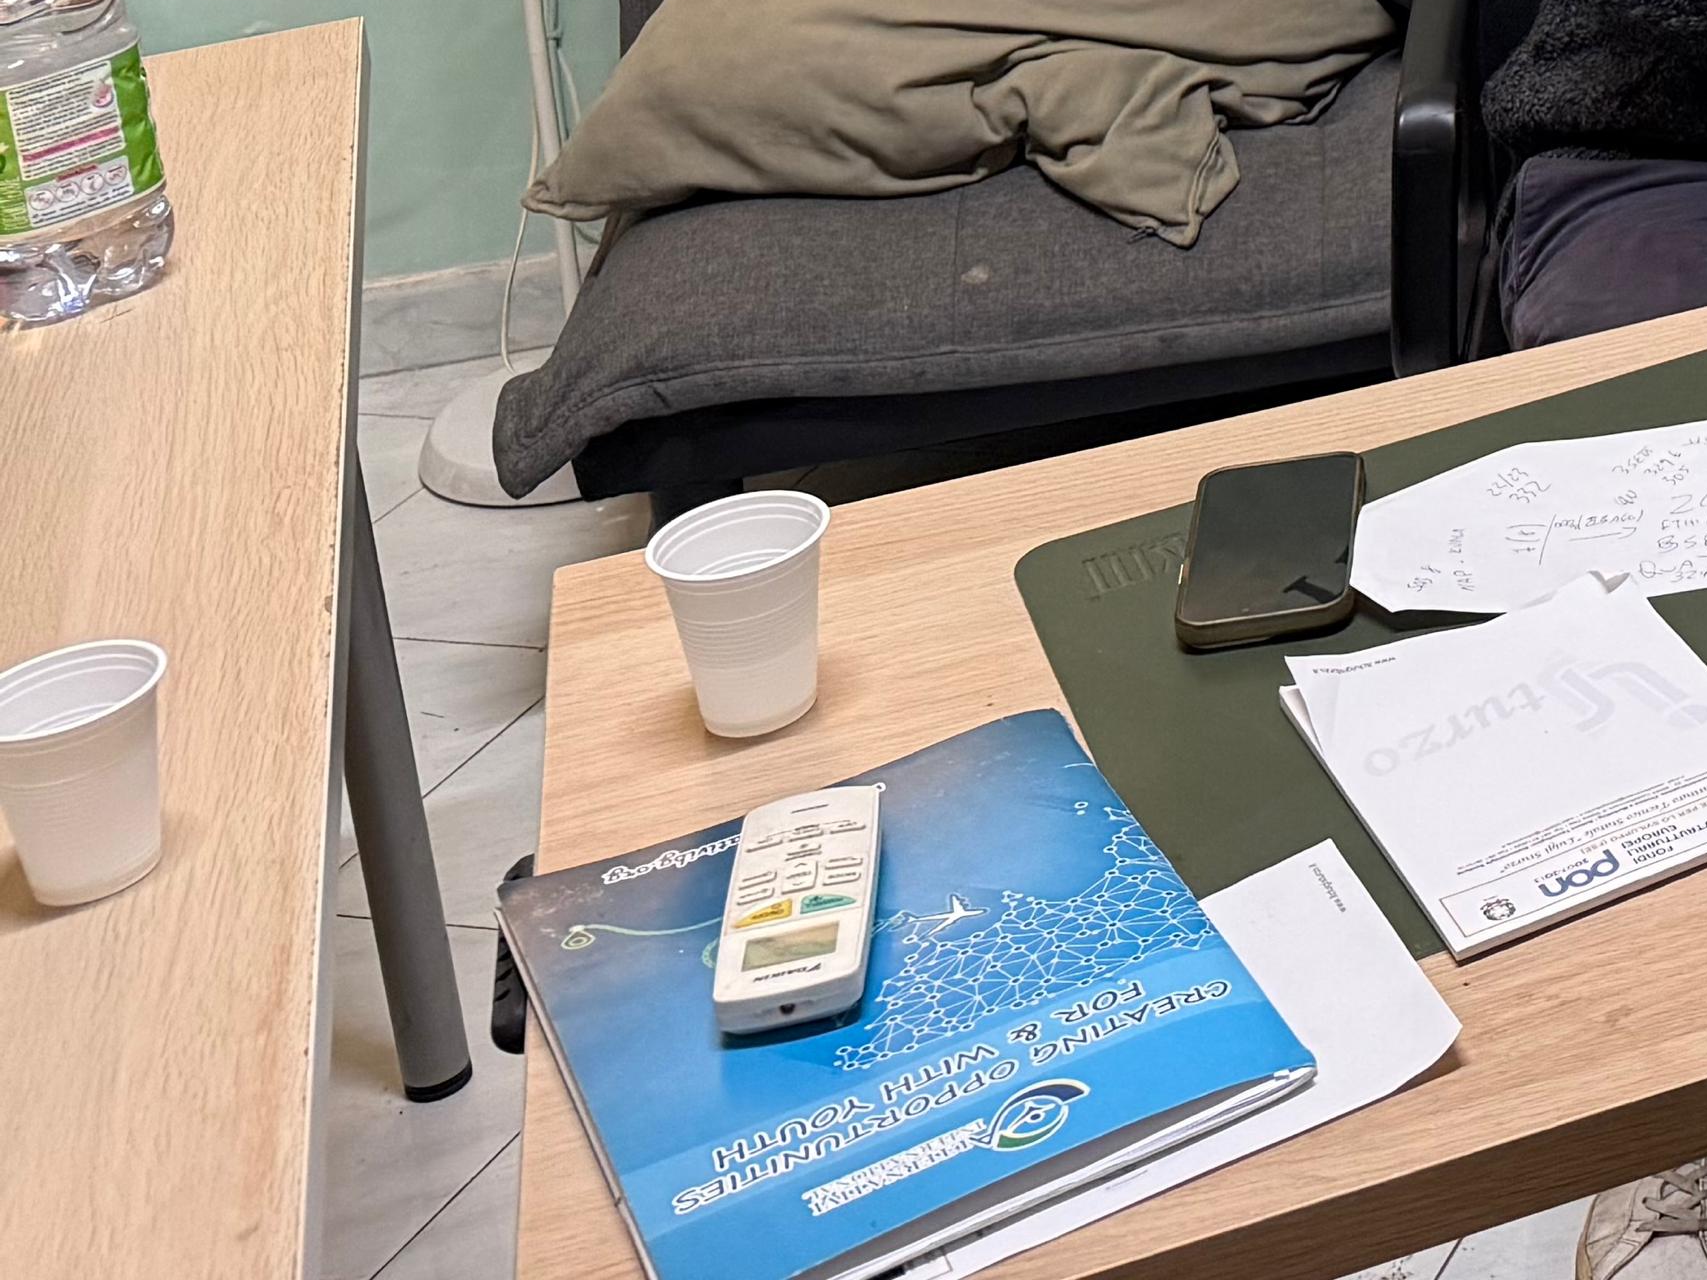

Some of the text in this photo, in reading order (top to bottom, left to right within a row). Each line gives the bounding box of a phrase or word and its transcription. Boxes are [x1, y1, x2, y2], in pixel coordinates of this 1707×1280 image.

[1620, 824, 1678, 849] EUROPEI
[1633, 844, 1674, 864] FONDI
[1536, 849, 1620, 898] pon
[752, 966, 808, 983] DAIKIN
[711, 979, 1146, 1171] FOR & WITH YOUTH
[671, 979, 1233, 1216] CREATING OPPORTUNITIES
